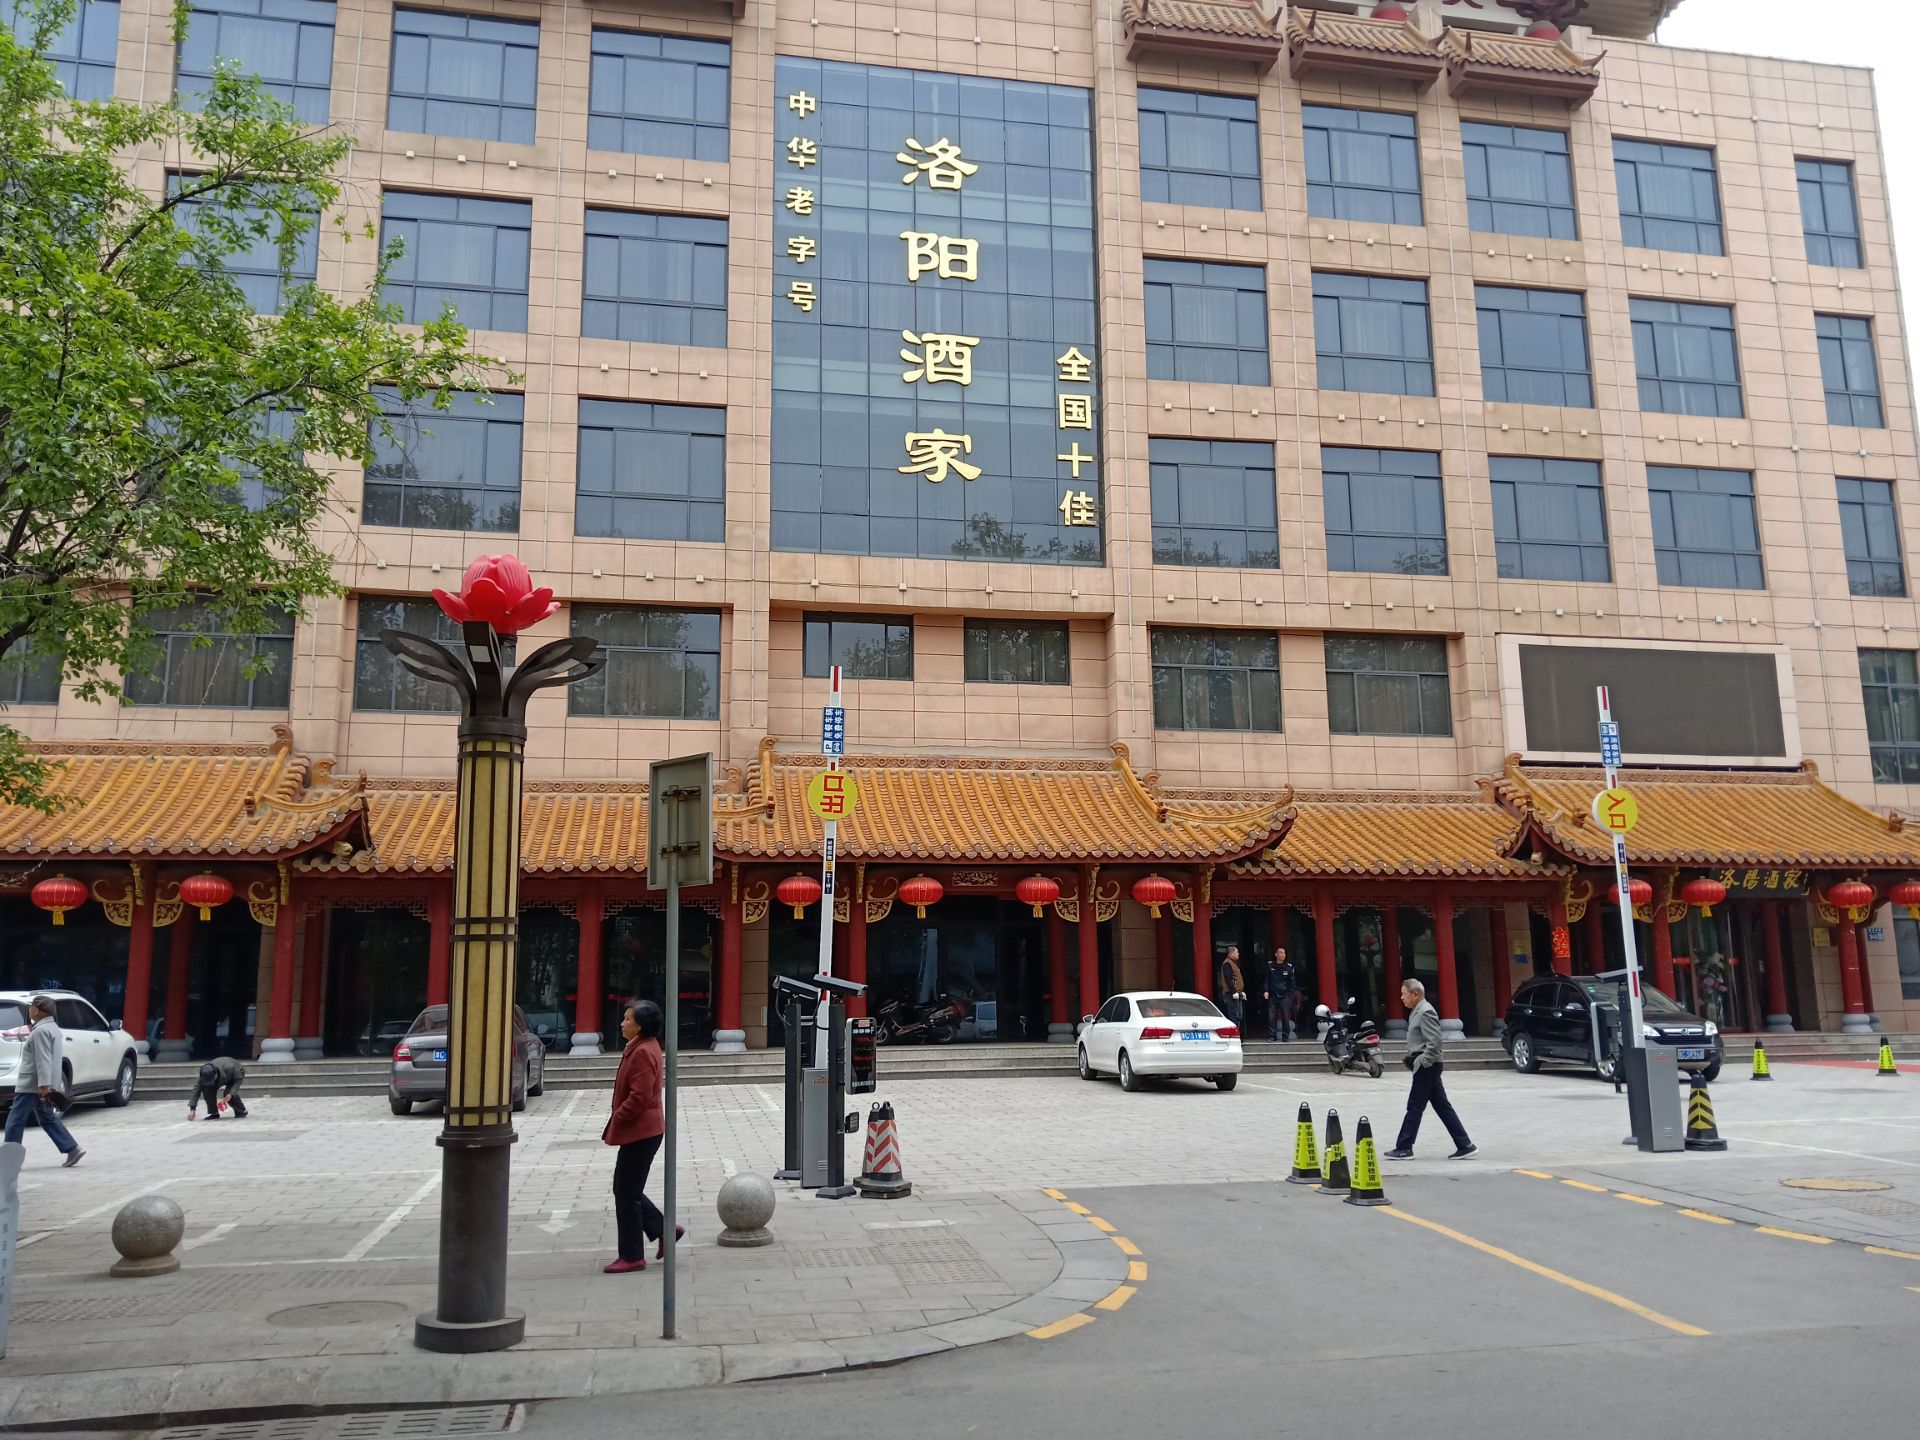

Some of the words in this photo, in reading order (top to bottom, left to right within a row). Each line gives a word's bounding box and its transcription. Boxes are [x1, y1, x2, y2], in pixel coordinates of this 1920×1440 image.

[786, 90, 817, 312] 中华老字号
[896, 136, 983, 484] 洛阳酒家
[1056, 346, 1099, 528] 全国十佳
[825, 708, 834, 740] 用餐车辆
[833, 708, 843, 740] 免费停车
[820, 775, 845, 814] 出口
[1606, 792, 1627, 829] 入口
[1719, 868, 1802, 890] 洛陽酒家
